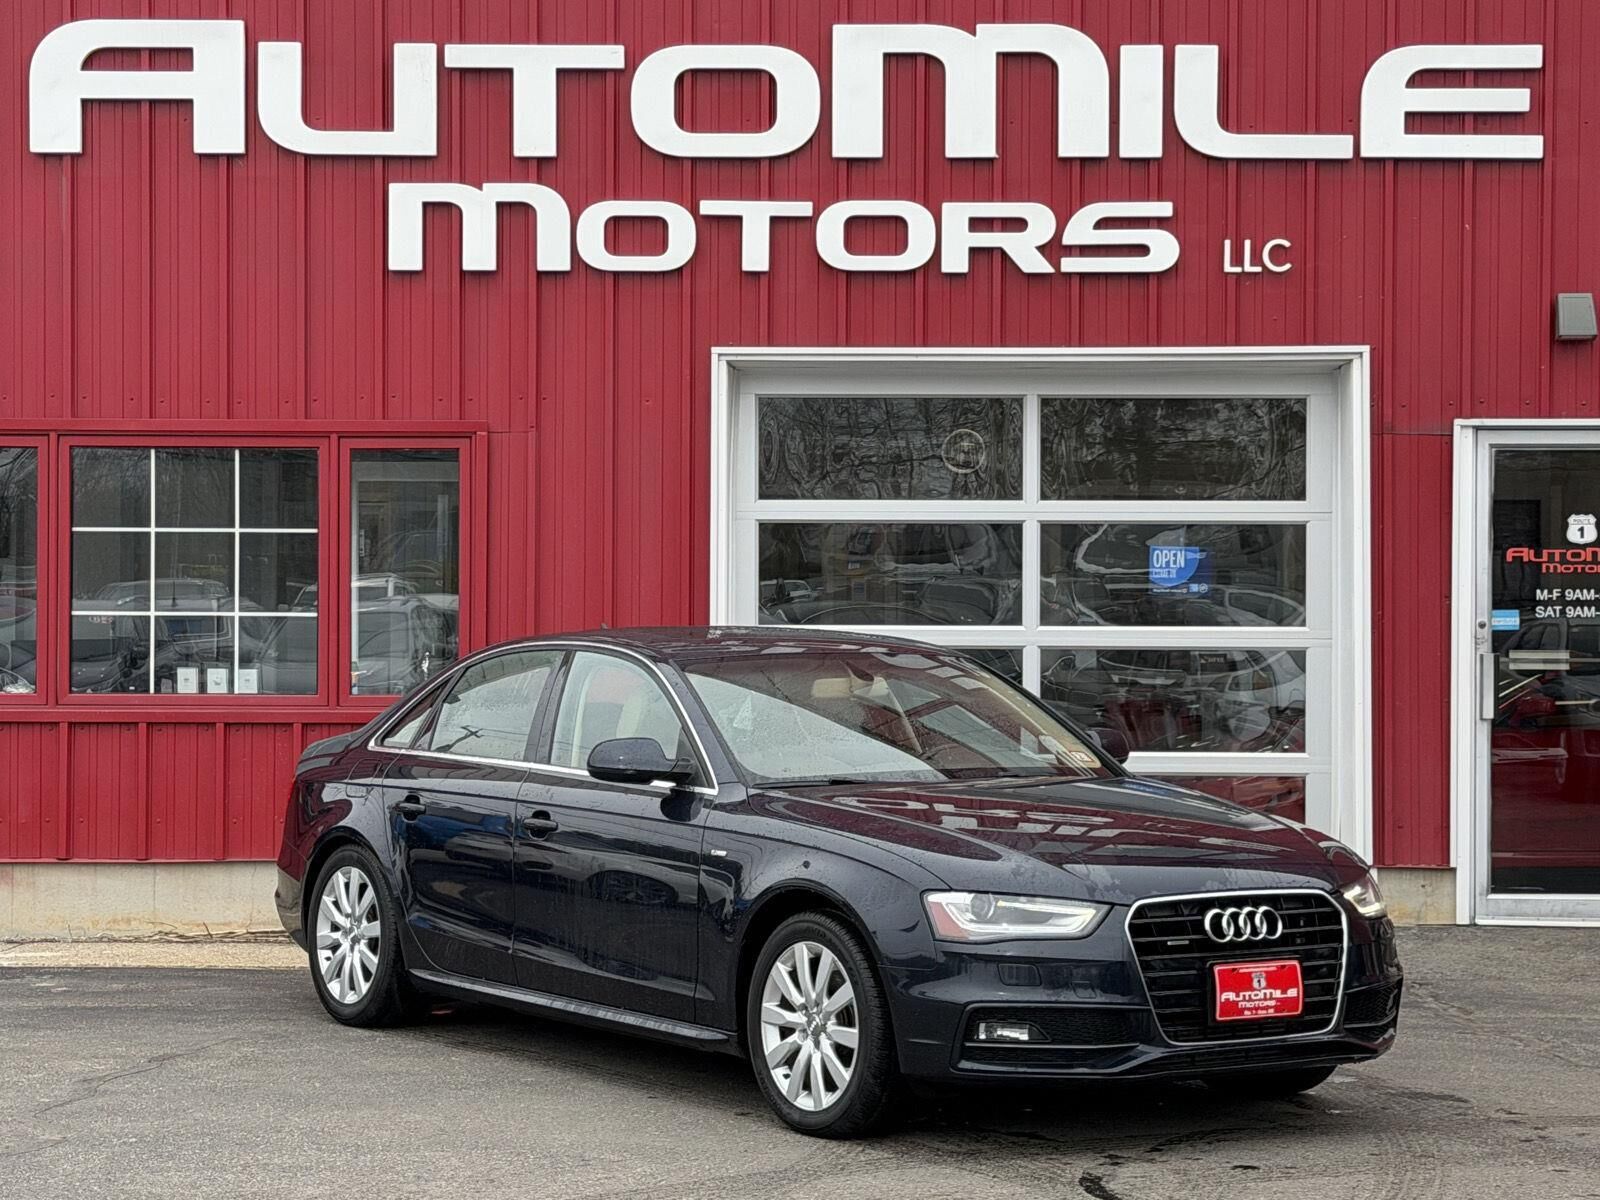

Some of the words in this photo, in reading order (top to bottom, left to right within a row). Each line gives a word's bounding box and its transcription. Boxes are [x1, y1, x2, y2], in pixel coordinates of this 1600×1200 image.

[28, 18, 1544, 160] AUTOMILE
[387, 182, 1181, 275] MOTORS
[1222, 238, 1293, 274] LLC
[1577, 526, 1585, 539] 1
[1152, 549, 1185, 568] OPEN
[1541, 563, 1600, 573] MOTO
[1535, 588, 1562, 601] M-F
[1564, 588, 1600, 601] 9AM-
[1535, 606, 1563, 618] SAT
[1565, 606, 1600, 618] 9AM-
[1220, 987, 1298, 1003] AUTOMILE
[1238, 1000, 1277, 1009] MOTORS
